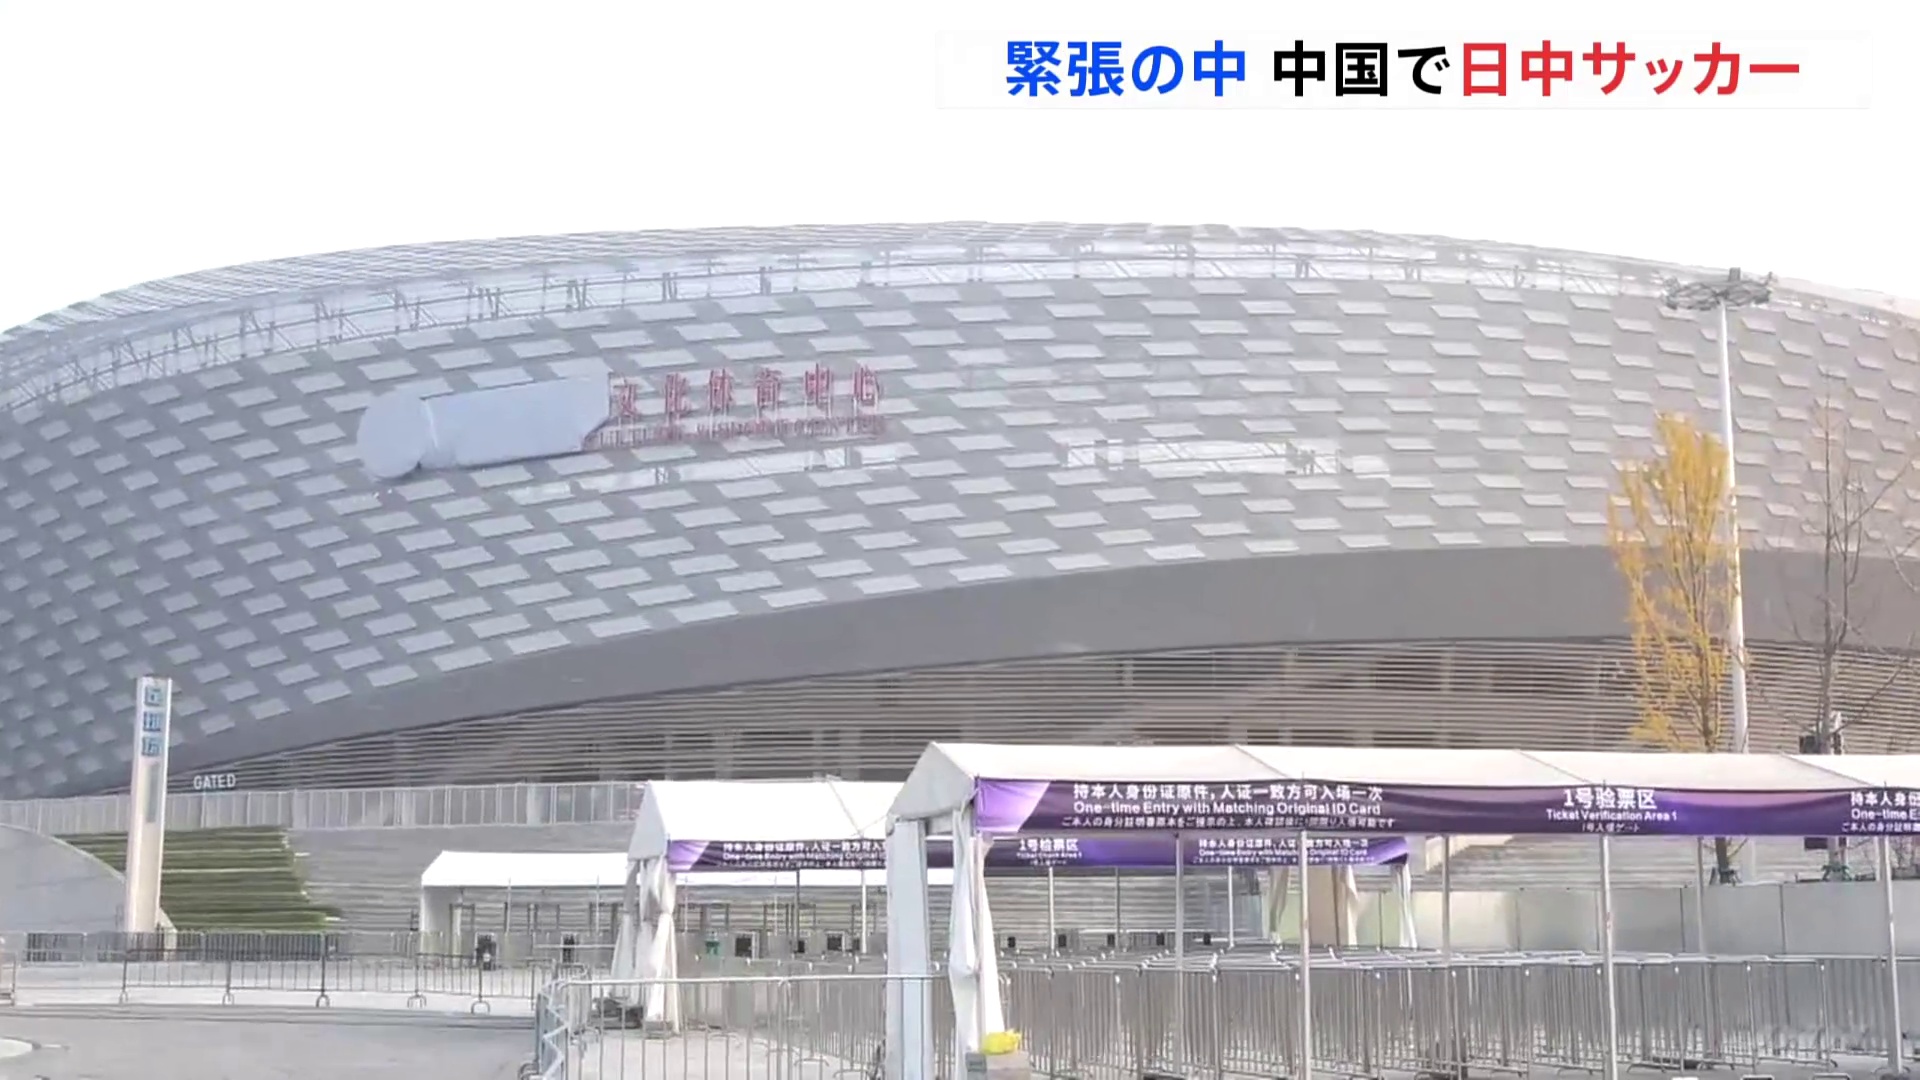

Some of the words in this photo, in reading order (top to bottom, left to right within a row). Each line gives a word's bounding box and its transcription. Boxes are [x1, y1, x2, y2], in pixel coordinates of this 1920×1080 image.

[1563, 786, 1658, 810] 1号验票区
[1073, 801, 1141, 815] One-time
[1143, 801, 1179, 816] Entry
[1182, 801, 1210, 815] with
[1213, 801, 1275, 817] Matching
[1276, 802, 1330, 817] Original
[1332, 803, 1347, 815] ID
[1349, 802, 1381, 816] Card
[1546, 808, 1580, 821] Ticket
[1581, 809, 1643, 821] Verification
[1644, 810, 1670, 821] Area
[1670, 810, 1678, 821] 1
[1851, 808, 1908, 821] One-time
